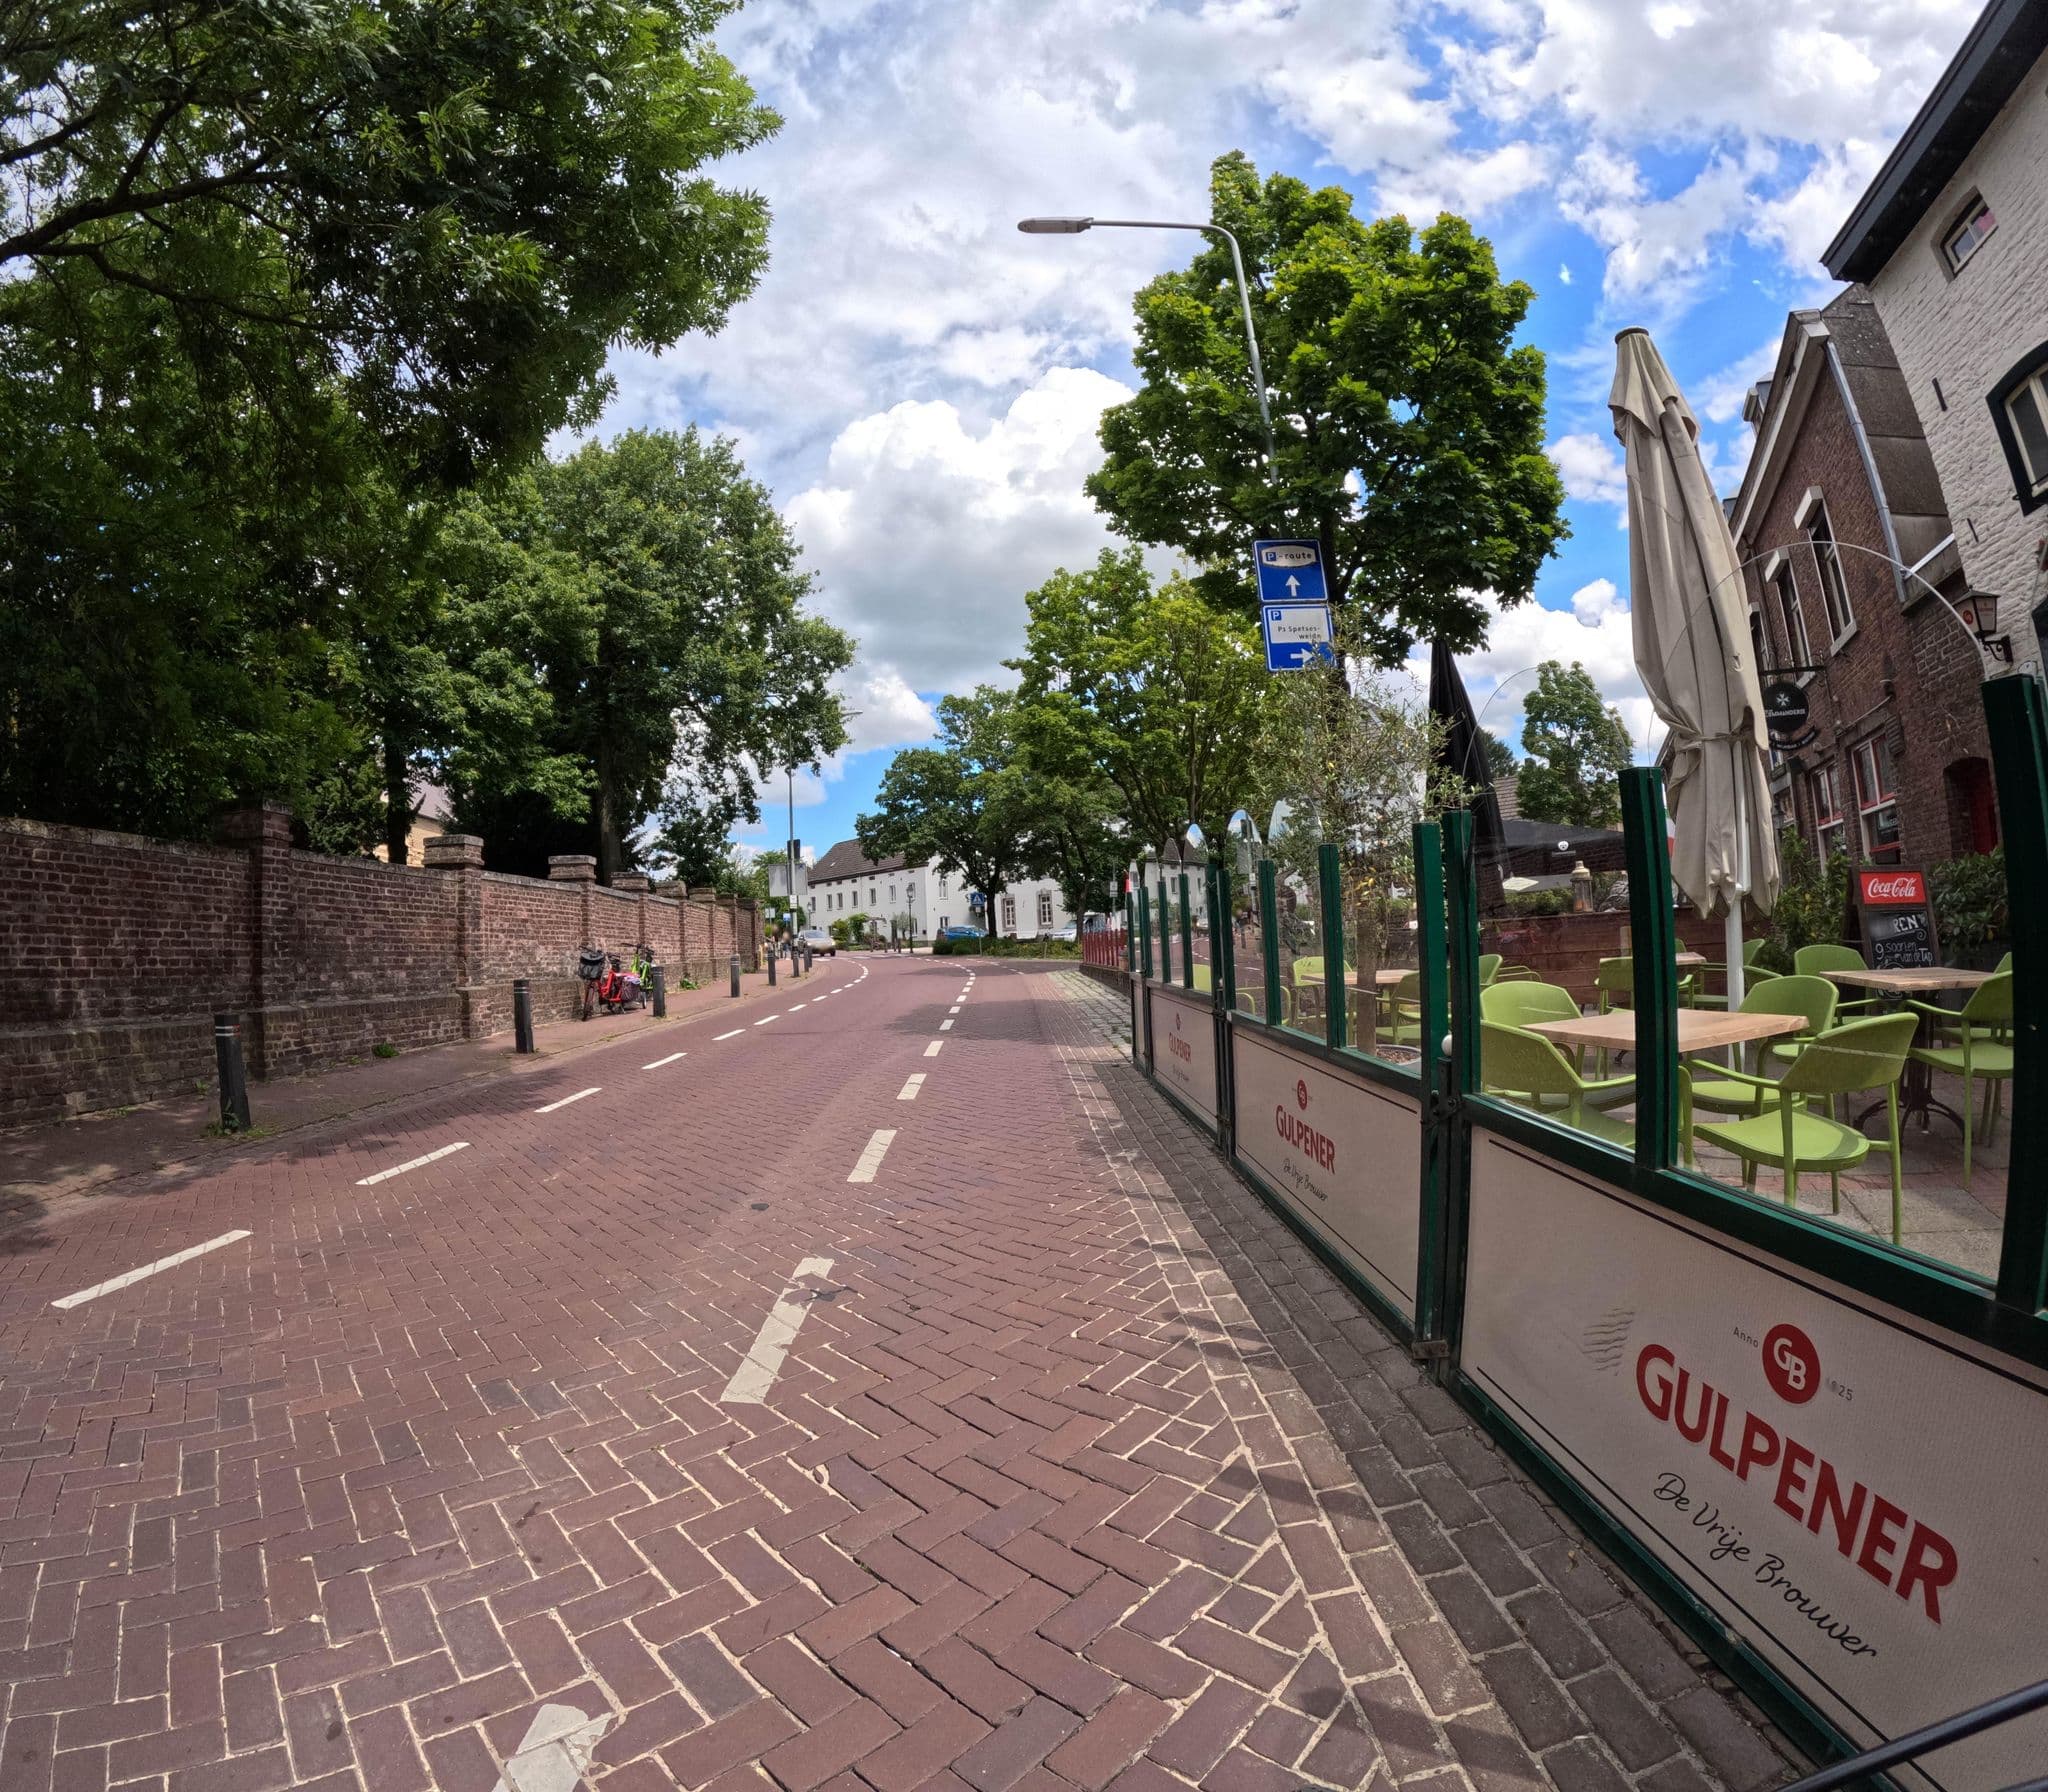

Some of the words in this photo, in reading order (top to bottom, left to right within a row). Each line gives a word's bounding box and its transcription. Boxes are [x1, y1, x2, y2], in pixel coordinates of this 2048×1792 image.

[1868, 878, 1916, 898] Coca-Cola
[1875, 943, 1885, 960] 9
[1275, 1104, 1336, 1175] GULPENER
[1733, 1326, 1760, 1348] Anno
[1773, 1337, 1807, 1391] GB
[1636, 1343, 1959, 1625] GULPENER
[1653, 1472, 1691, 1512] De
[1692, 1501, 1751, 1562] Vrije
[1755, 1553, 1878, 1658] Brouwer
